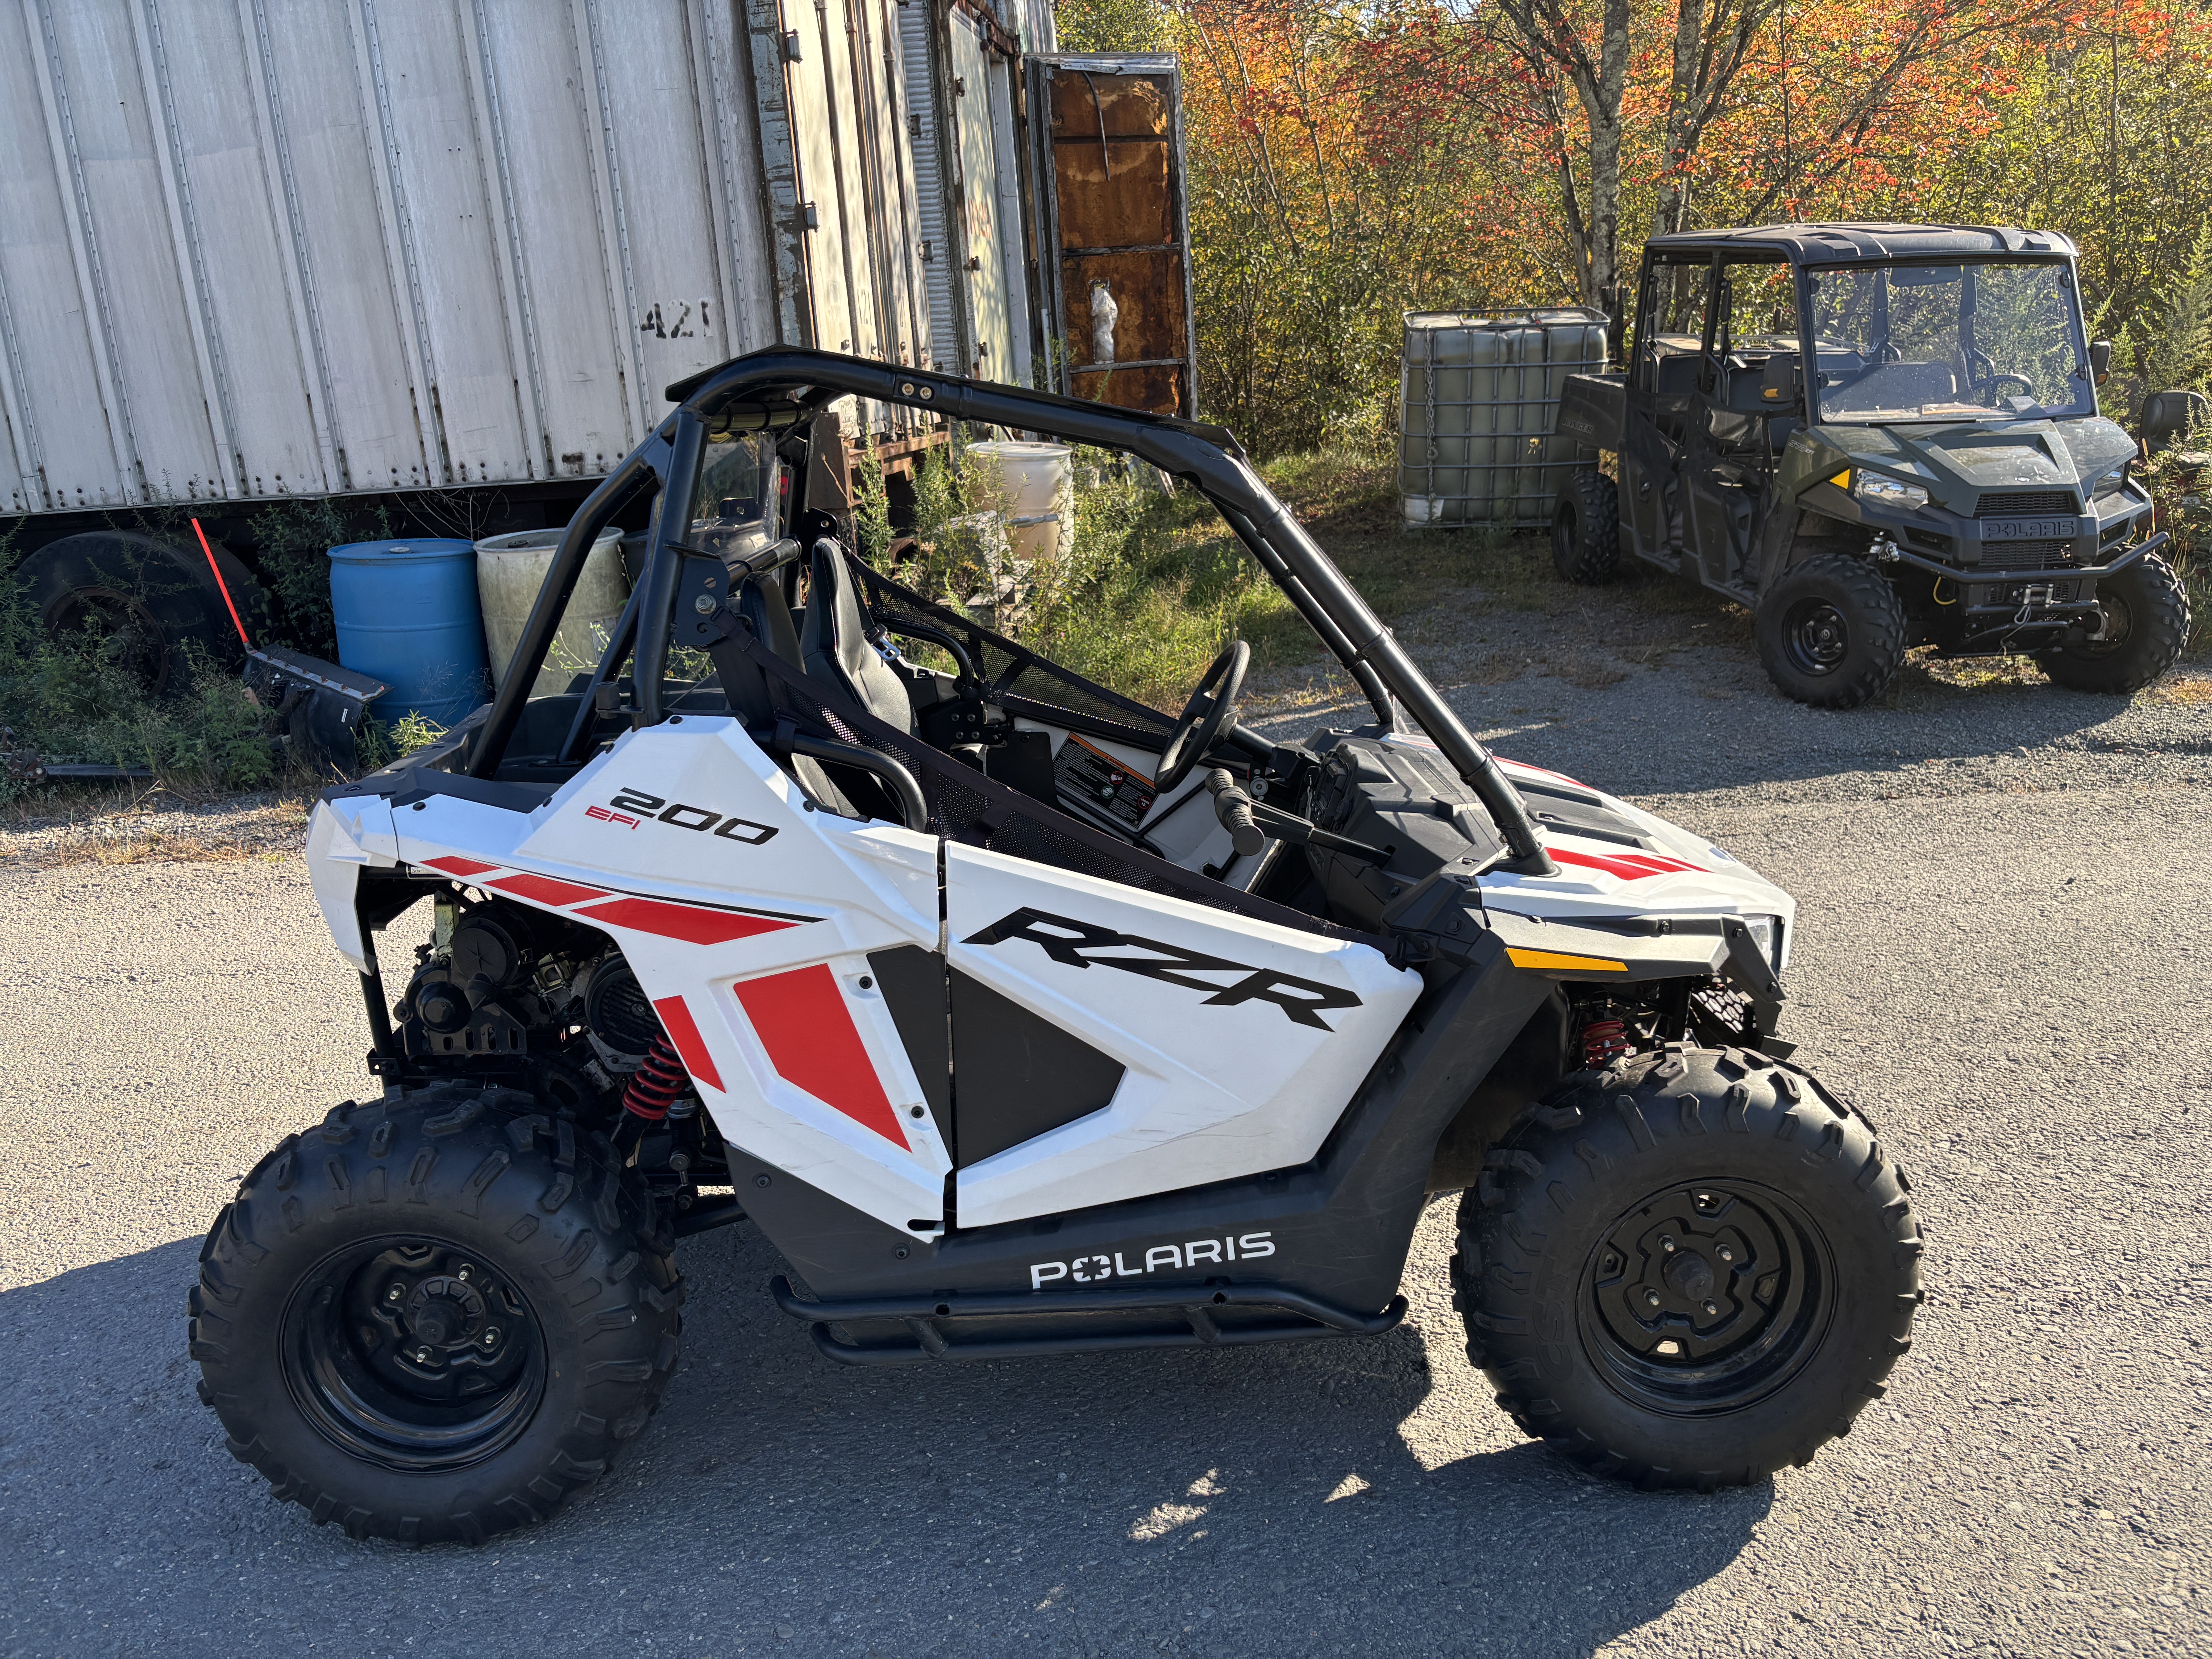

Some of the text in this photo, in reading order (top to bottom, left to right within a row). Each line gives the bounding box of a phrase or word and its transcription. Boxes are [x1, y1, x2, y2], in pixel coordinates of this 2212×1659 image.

[1985, 520, 2074, 538] POLARIS
[585, 787, 779, 845] EFI 200
[959, 906, 1364, 1033] RZR
[1030, 1231, 1275, 1289] POLARIS
[1532, 1255, 1573, 1382] CST
